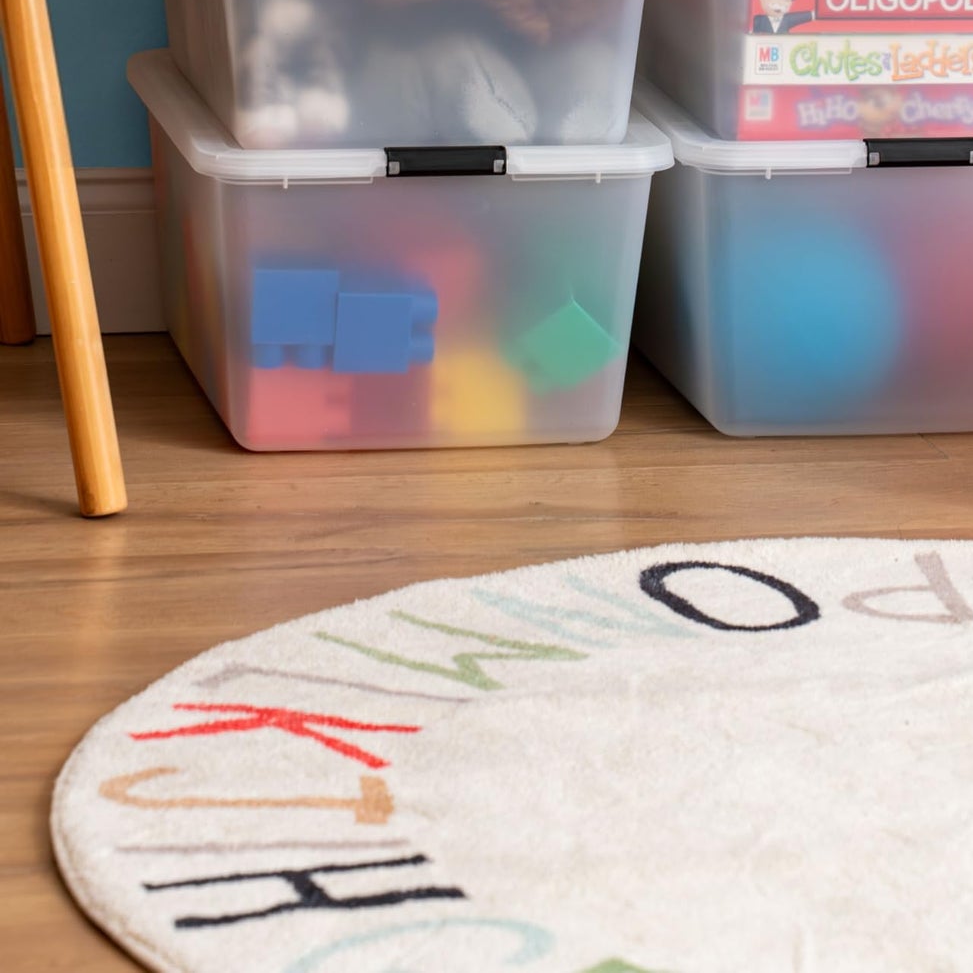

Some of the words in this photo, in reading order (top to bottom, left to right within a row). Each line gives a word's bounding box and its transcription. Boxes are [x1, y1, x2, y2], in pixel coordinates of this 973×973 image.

[759, 46, 779, 62] MB
[789, 39, 883, 82] Chutes
[638, 561, 822, 632] O
